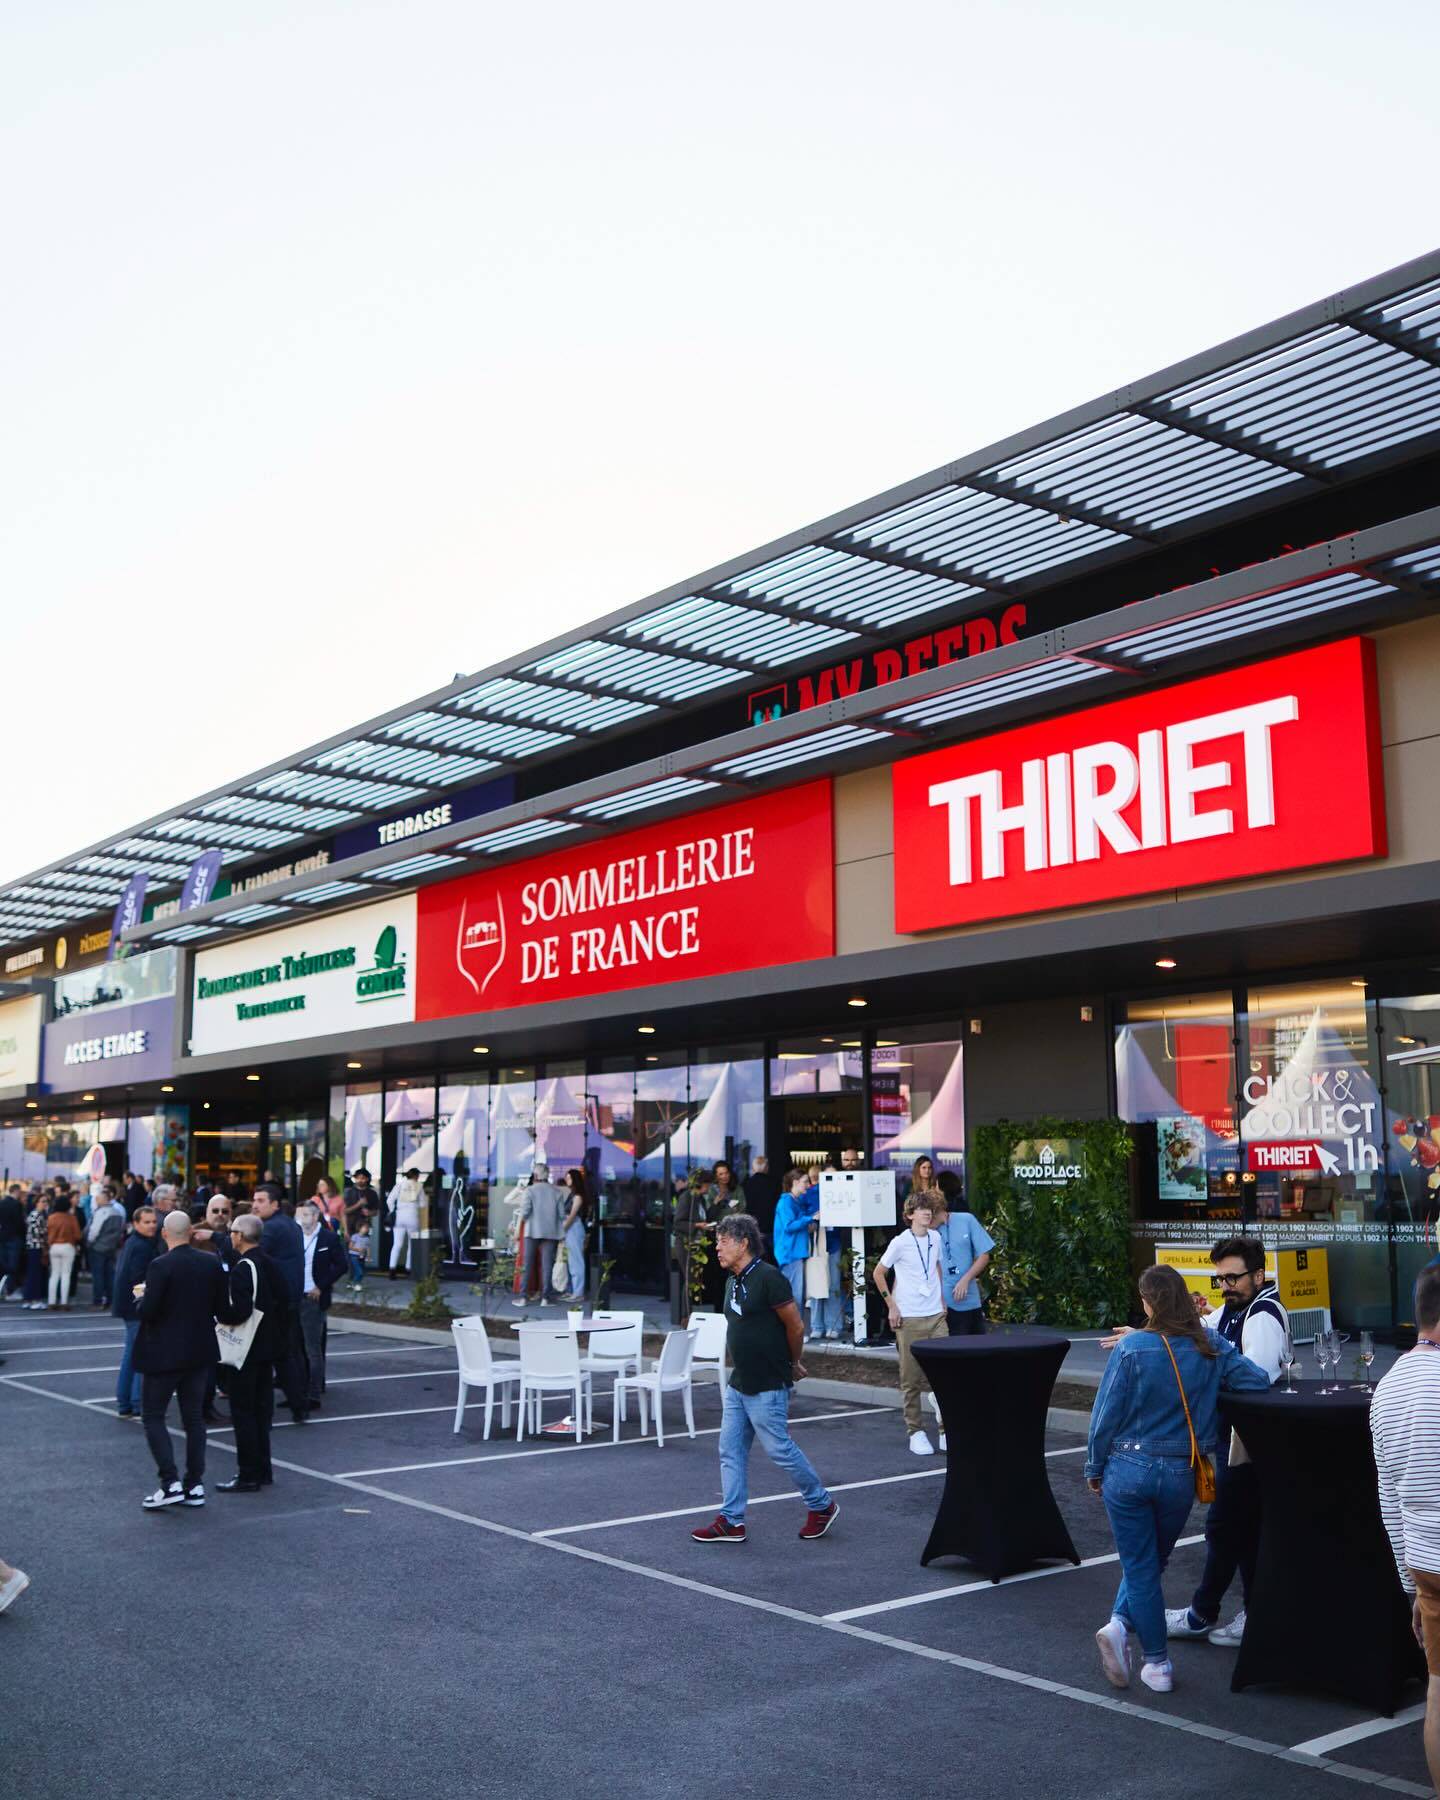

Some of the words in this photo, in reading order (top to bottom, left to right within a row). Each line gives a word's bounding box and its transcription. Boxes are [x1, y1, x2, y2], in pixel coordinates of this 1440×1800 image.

[929, 694, 1298, 886] THIRIET
[378, 803, 452, 845] TERRASSE
[521, 827, 755, 925] SOMMELLERIE
[520, 936, 560, 984] DE
[570, 906, 700, 975] FRANCE
[266, 964, 282, 983] DE
[64, 1037, 103, 1065] ACCES
[103, 1030, 146, 1059] ETAGE
[1243, 1071, 1331, 1106] CLICK
[1333, 1070, 1355, 1100] &
[1248, 1102, 1376, 1137] COLLECT
[1254, 1145, 1313, 1166] THIRIET
[1343, 1136, 1379, 1171] 1h
[1014, 1165, 1043, 1178] FOOD
[1044, 1165, 1081, 1178] PLACE
[1167, 1231, 1181, 1239] 1902
[1262, 1233, 1277, 1241] 1902
[1279, 1233, 1305, 1241] MAISON
[1307, 1233, 1334, 1241] THIRIET
[1335, 1234, 1361, 1242] DEPUIS
[1363, 1234, 1380, 1242] 1902
[1381, 1235, 1414, 1243] MAISON
[1208, 1223, 1233, 1231] MAISON
[1264, 1224, 1288, 1232] DEPUIS
[1289, 1224, 1305, 1232] 1902
[1307, 1224, 1335, 1232] MAISON
[1336, 1224, 1363, 1232] THIRIET
[1396, 1225, 1414, 1233] 1902
